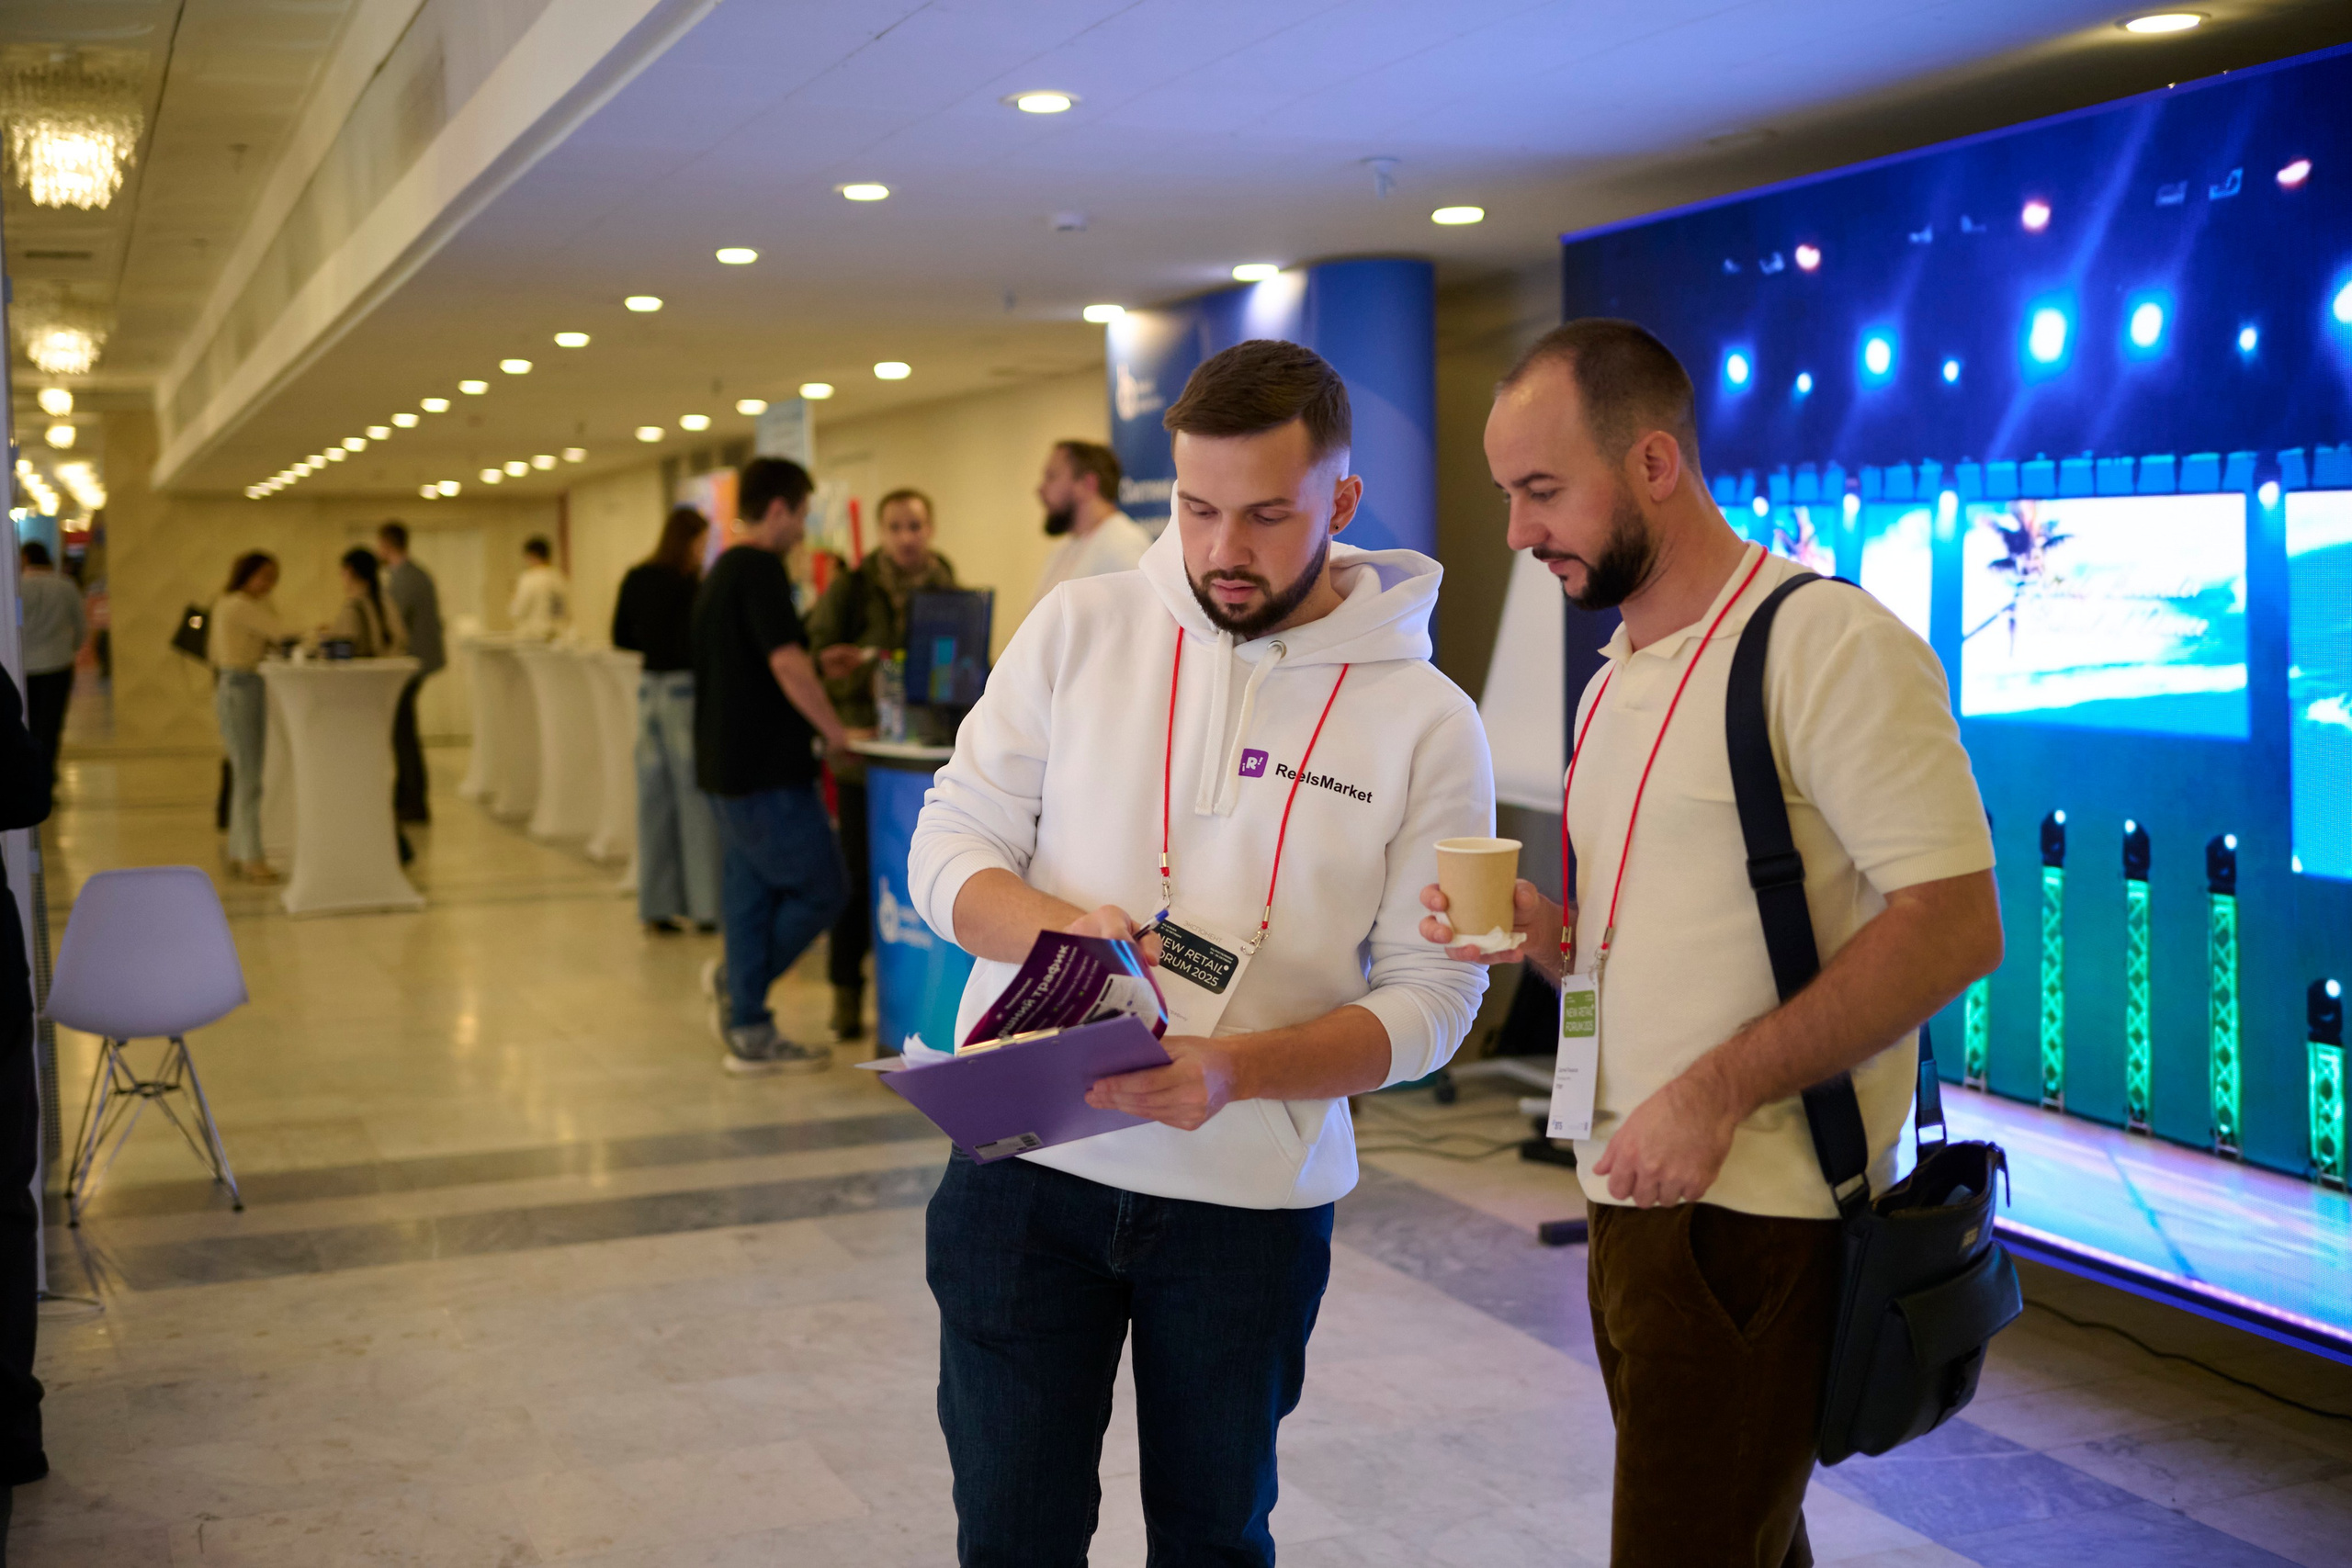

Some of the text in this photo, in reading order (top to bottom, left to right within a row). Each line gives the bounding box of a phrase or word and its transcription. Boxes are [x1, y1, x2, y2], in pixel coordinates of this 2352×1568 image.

[1275, 763, 1373, 803] ReelsMarket
[1182, 920, 1223, 943] ЭКСПОНЕНТ
[1031, 944, 1069, 998] трафик
[1159, 950, 1193, 973] ORUM
[1191, 966, 1219, 987] 2025
[1184, 948, 1224, 976] RETAIL
